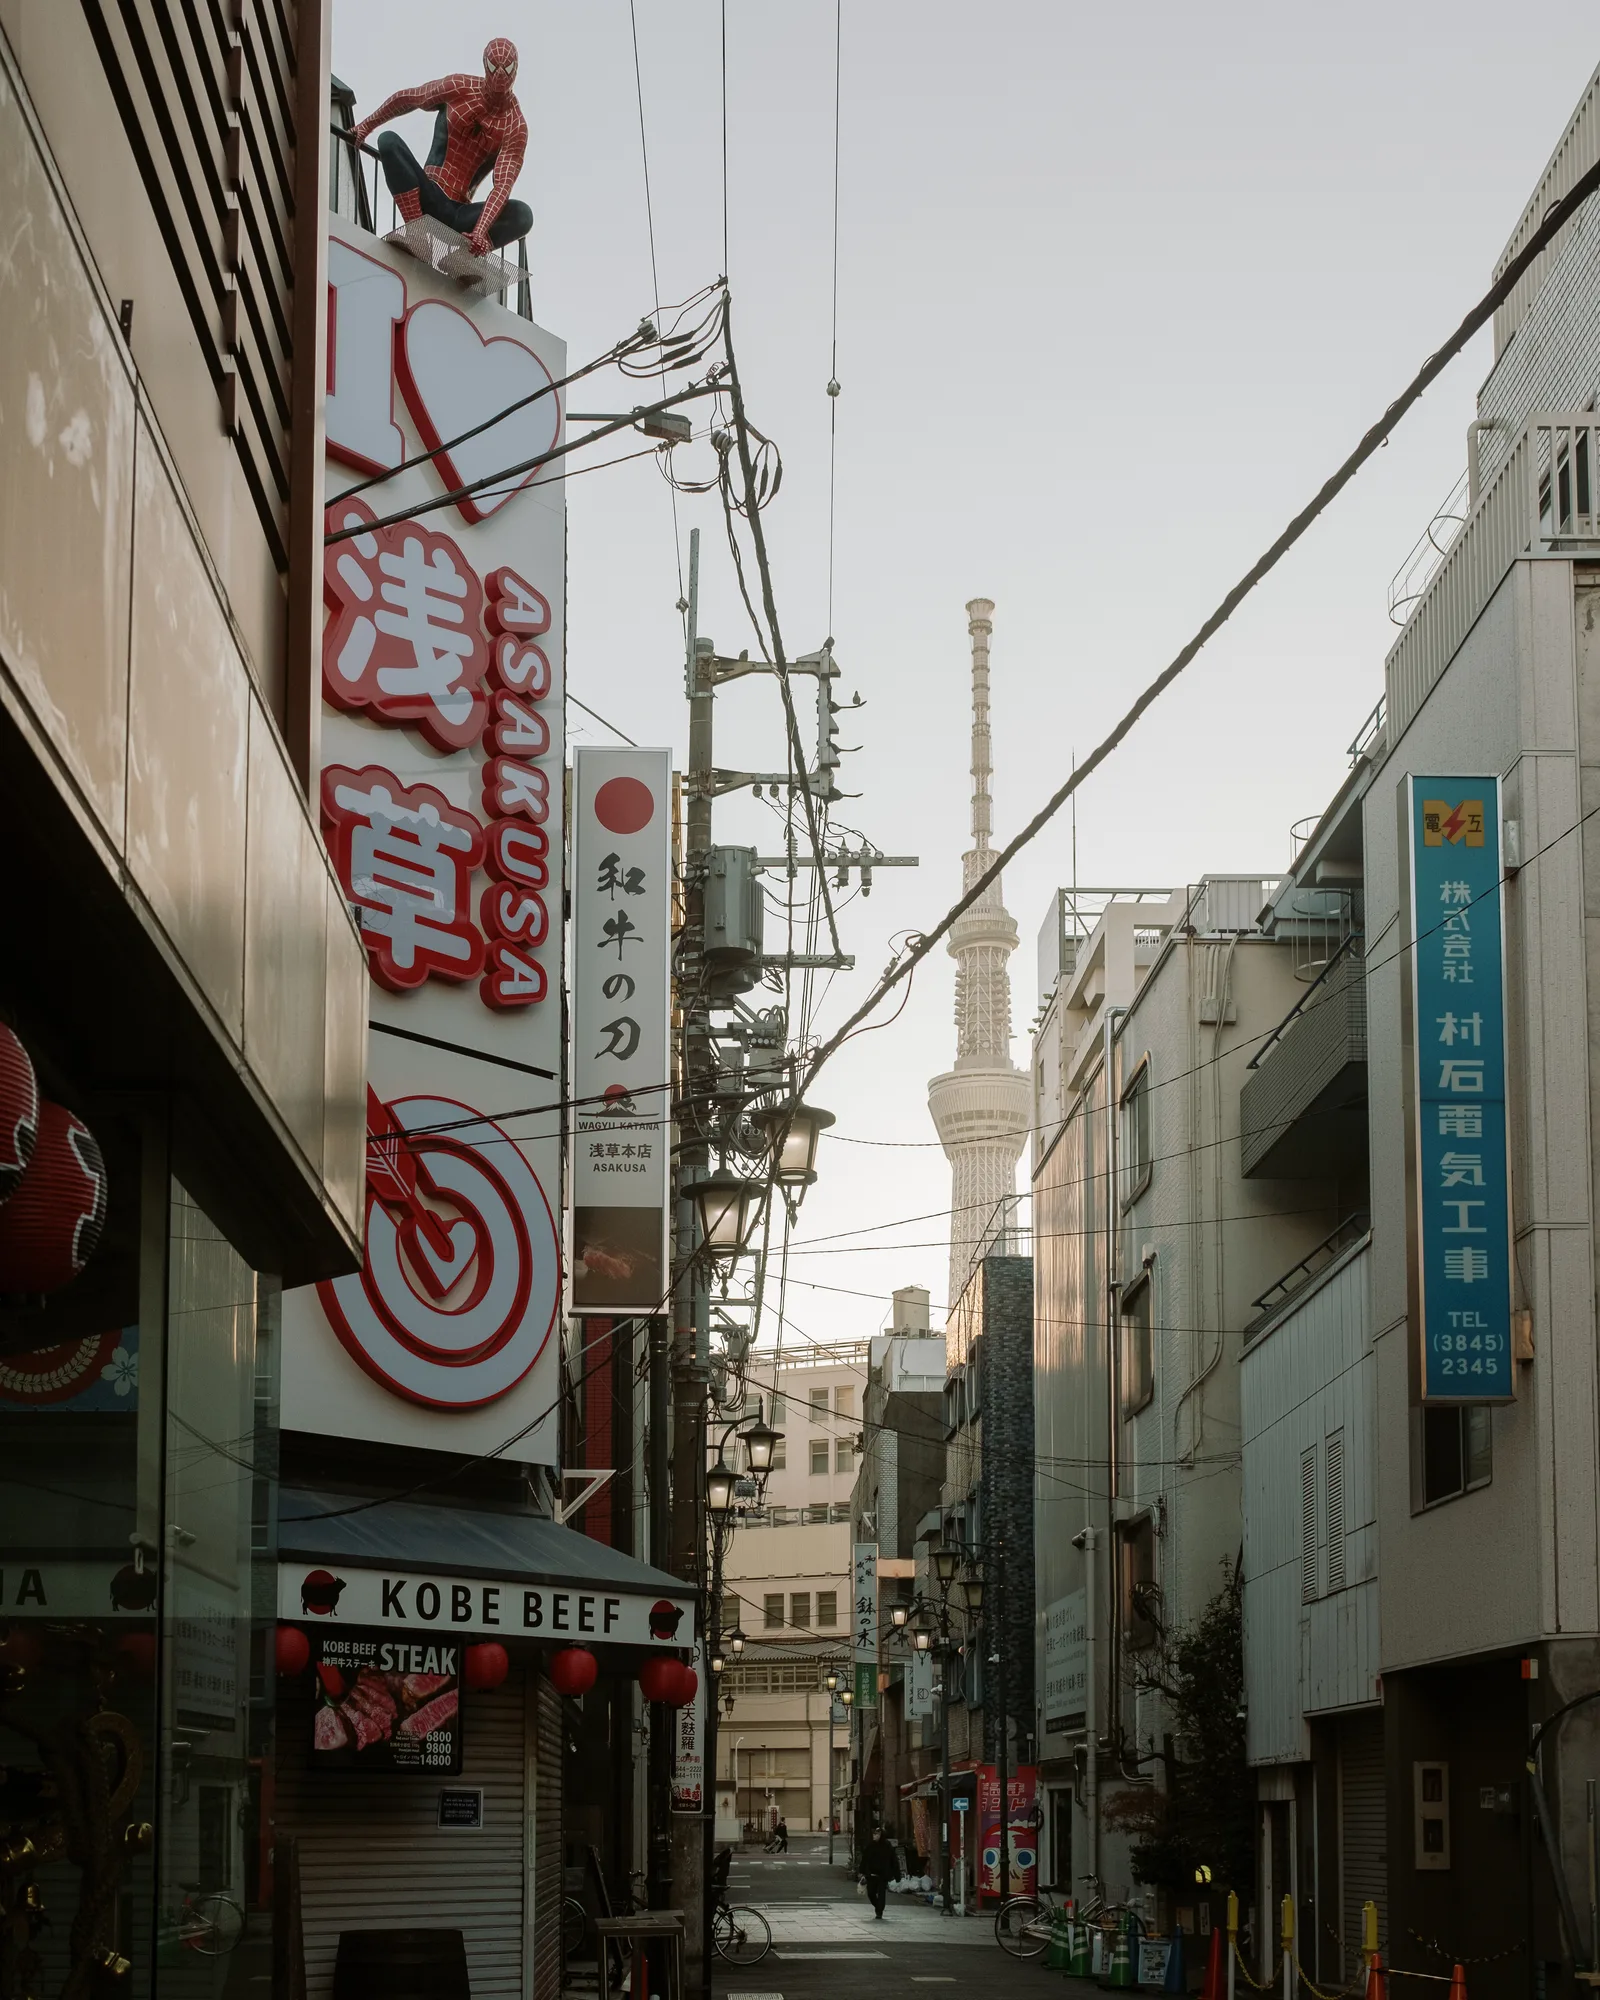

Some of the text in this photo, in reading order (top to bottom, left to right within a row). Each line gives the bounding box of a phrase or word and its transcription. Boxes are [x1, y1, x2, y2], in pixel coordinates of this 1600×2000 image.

[328, 502, 483, 980] 浅草
[490, 568, 551, 1004] ASAKUSA
[1439, 880, 1474, 984] 株式会社
[594, 851, 647, 1061] 和牛の刀
[578, 1121, 660, 1131] WAGYU KATANA
[588, 1143, 653, 1159] 浅草本店
[1436, 1011, 1488, 1284] 村石電気工事
[592, 1163, 647, 1173] ASAKUSA
[1447, 1311, 1488, 1328] TEL
[1433, 1333, 1504, 1353] (3845)
[1441, 1357, 1498, 1376] 2345
[381, 1578, 621, 1634] KOBE BEEF
[323, 1640, 377, 1656] KOBE BEEF
[379, 1643, 457, 1675] STEAK
[426, 1730, 452, 1743] 6800
[426, 1742, 452, 1754] 9800
[420, 1754, 452, 1767] 14800
